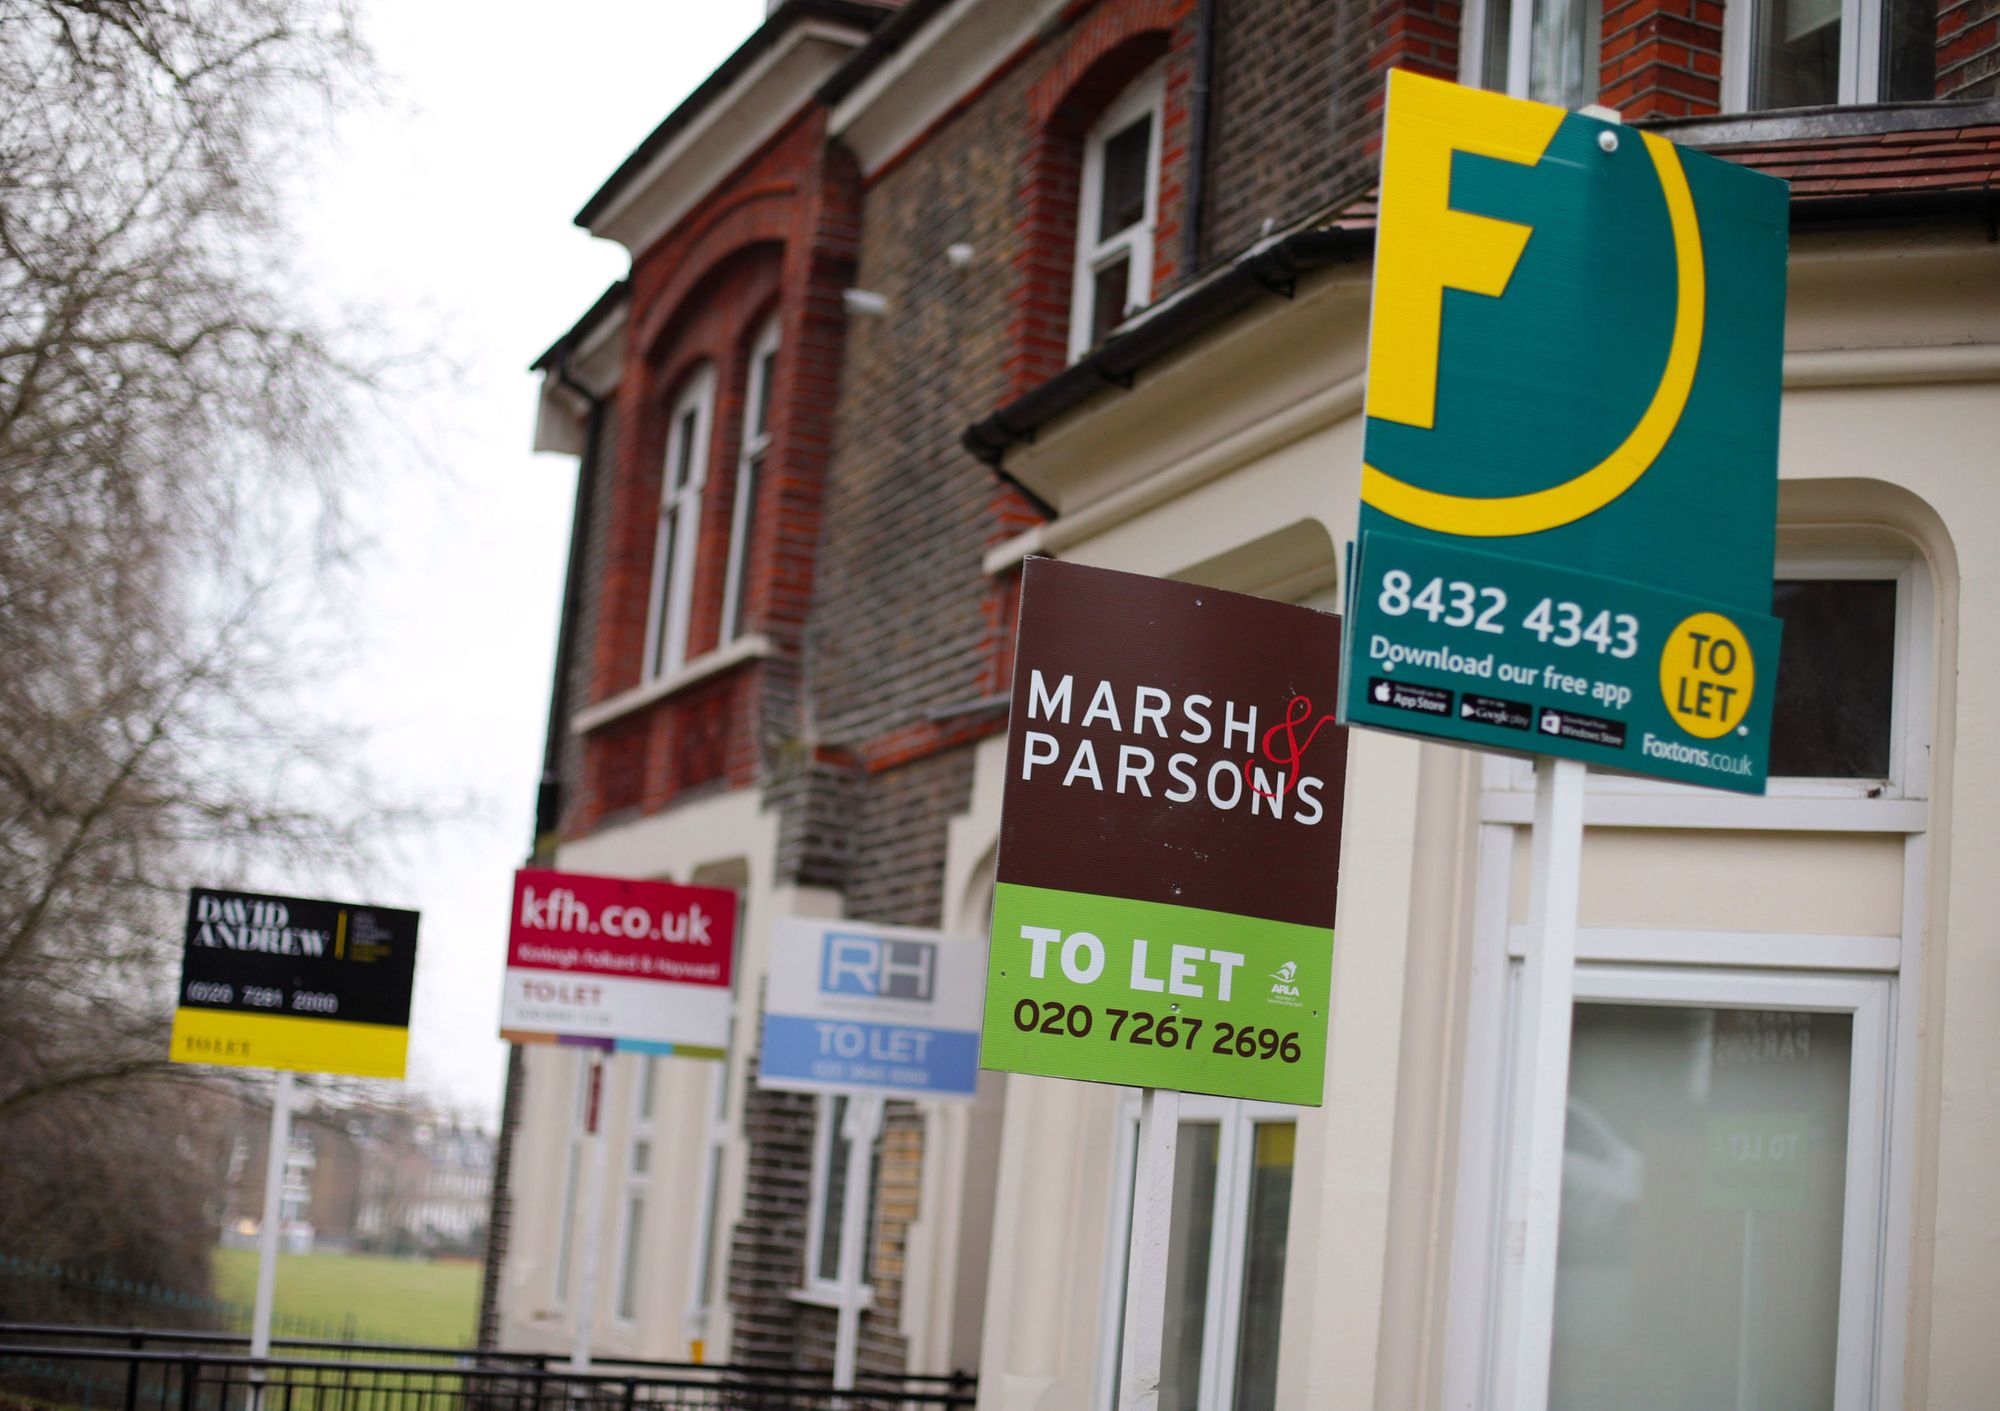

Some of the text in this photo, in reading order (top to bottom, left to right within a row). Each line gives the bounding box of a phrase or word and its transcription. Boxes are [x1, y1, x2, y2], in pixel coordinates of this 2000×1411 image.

[1378, 569, 1639, 659] 8432 4343
[1369, 634, 1632, 710] Download our free app
[1688, 631, 1737, 676] TO
[1392, 692, 1448, 713] App Store
[1475, 707, 1530, 728] Google play
[1677, 676, 1738, 722] LET
[1027, 669, 1337, 797] MARSH &
[1562, 725, 1623, 746] Windows Store
[1642, 732, 1752, 776] Foxtons.co.uk
[1022, 730, 1325, 826] PARSONS
[196, 895, 290, 930] DAVID
[520, 885, 712, 947] kfh.co.uk
[193, 920, 331, 957] ANDREW
[827, 936, 934, 998] RH
[1020, 924, 1245, 1002] TO LET
[520, 978, 606, 1004] TO LET
[1270, 983, 1301, 997] ARLA
[815, 1022, 935, 1063] TO LET
[1013, 998, 1302, 1064] 020 7267 2696
